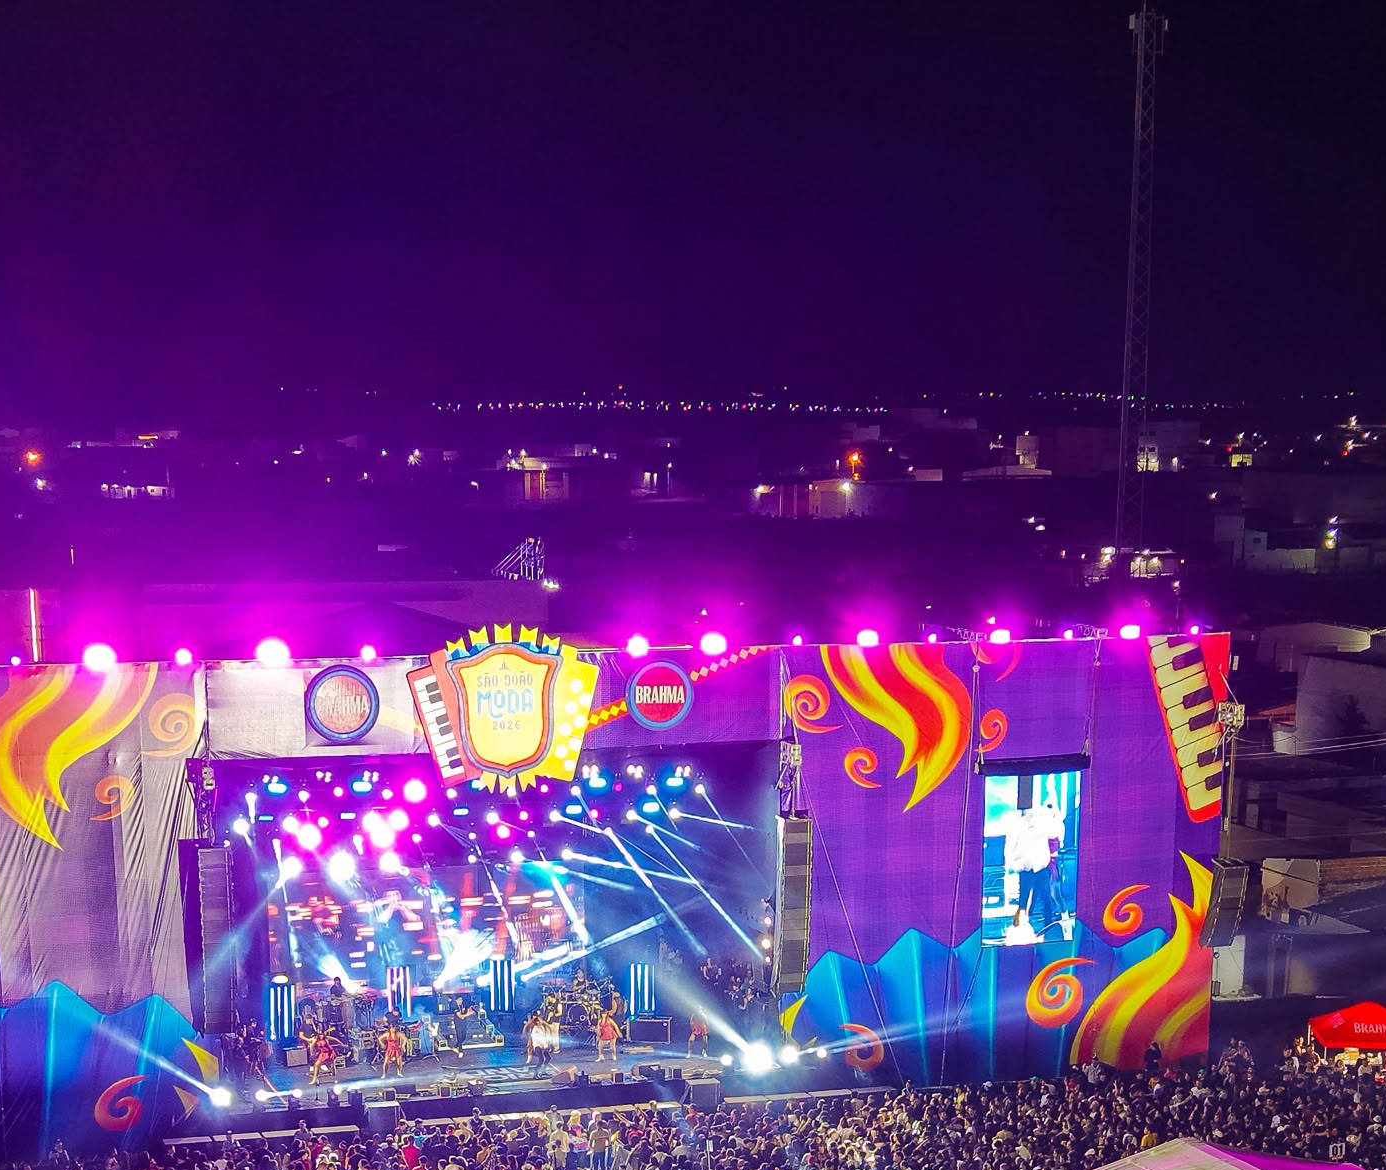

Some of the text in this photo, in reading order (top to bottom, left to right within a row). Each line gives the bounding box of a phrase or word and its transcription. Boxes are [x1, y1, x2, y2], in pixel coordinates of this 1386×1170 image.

[477, 671, 533, 687] SÃO JOÃO
[635, 685, 685, 704] BRAHMA
[316, 694, 369, 714] BRAHMA
[476, 688, 533, 719] MODA
[493, 721, 521, 730] 2026
[1332, 1145, 1343, 1156] 01
